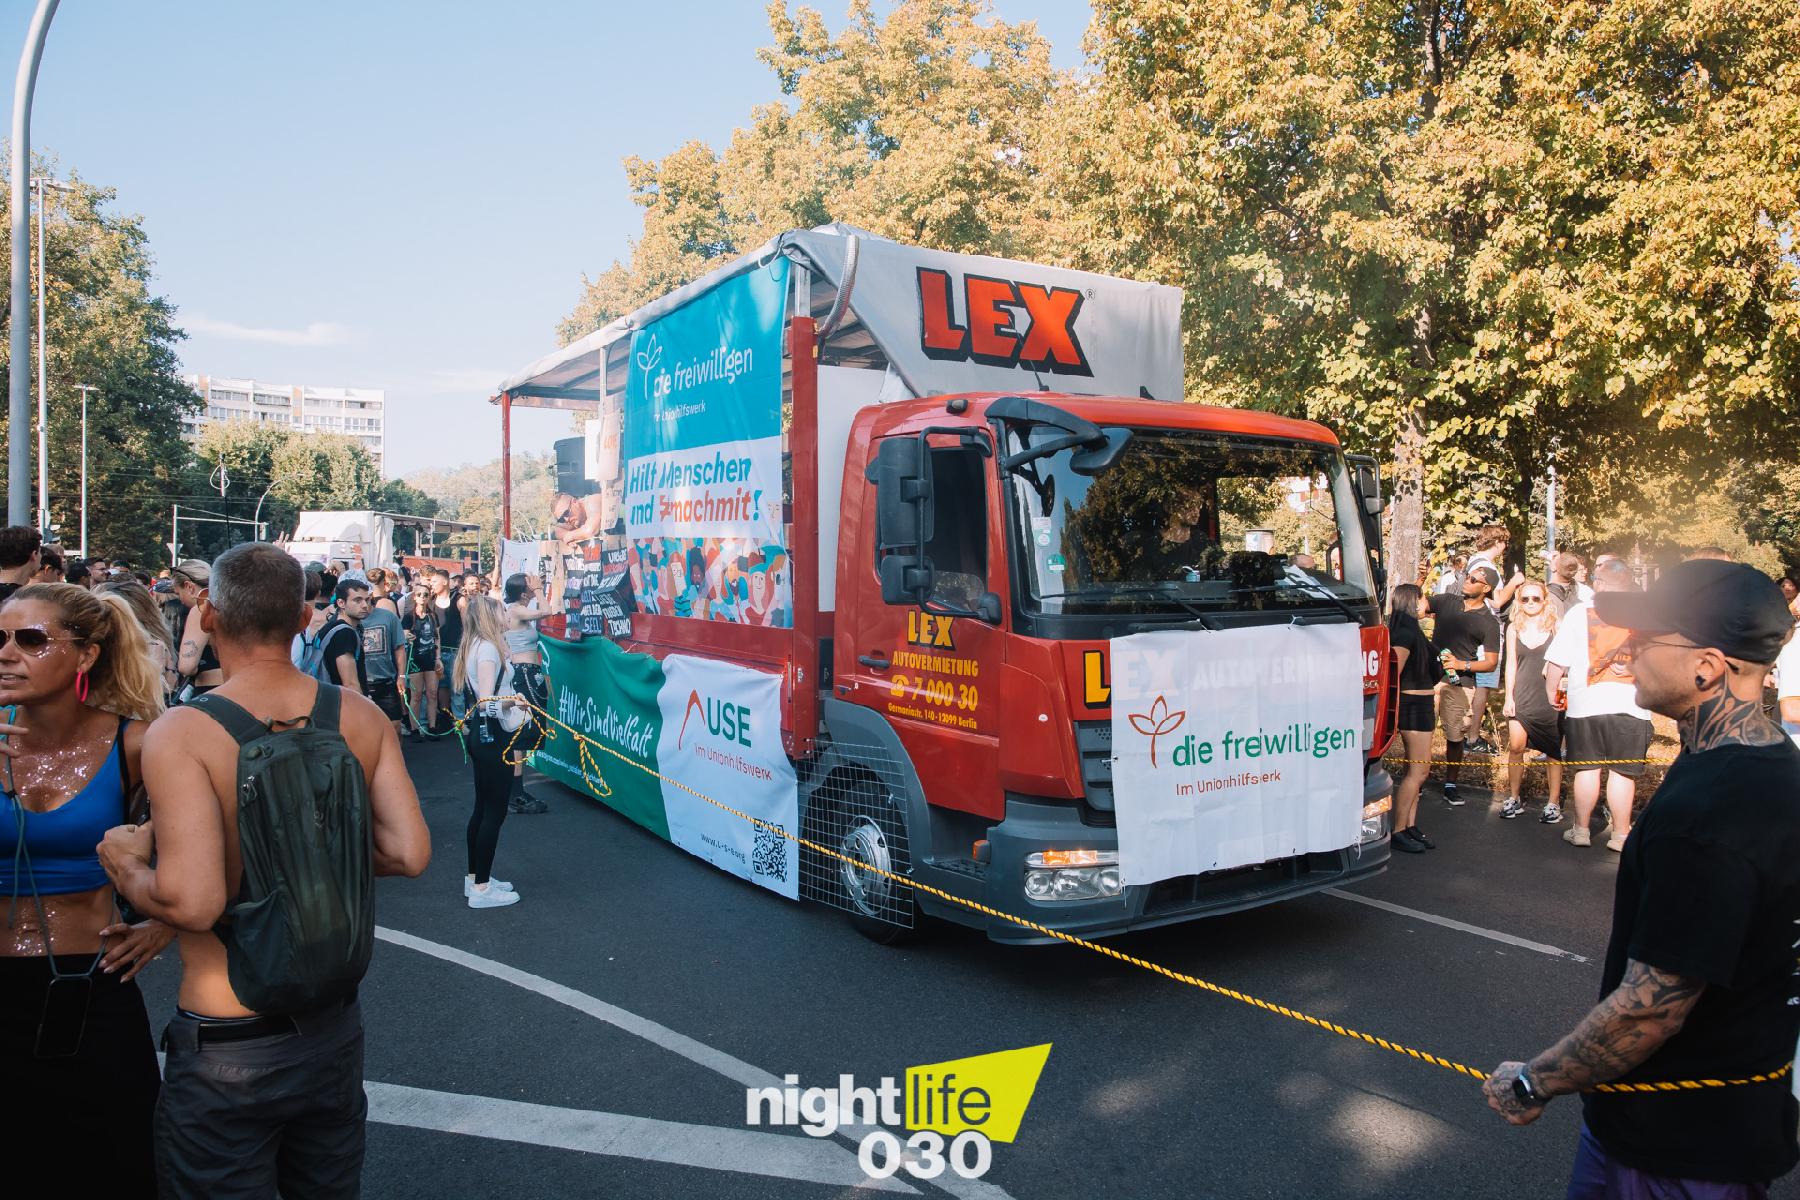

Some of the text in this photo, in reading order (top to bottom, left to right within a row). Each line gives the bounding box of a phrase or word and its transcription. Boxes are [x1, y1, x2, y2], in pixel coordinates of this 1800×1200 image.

[916, 266, 1094, 378] LEX
[658, 450, 753, 489] Menschen
[908, 610, 955, 651] LEX
[892, 650, 979, 678] AUTOVERMIETUNG
[911, 676, 979, 712] 7 000 30
[707, 696, 752, 749] USE
[707, 746, 773, 781] Unionhlfswerk
[1172, 722, 1356, 767] die freiwilligen
[1197, 769, 1281, 794] Unionhilfserk
